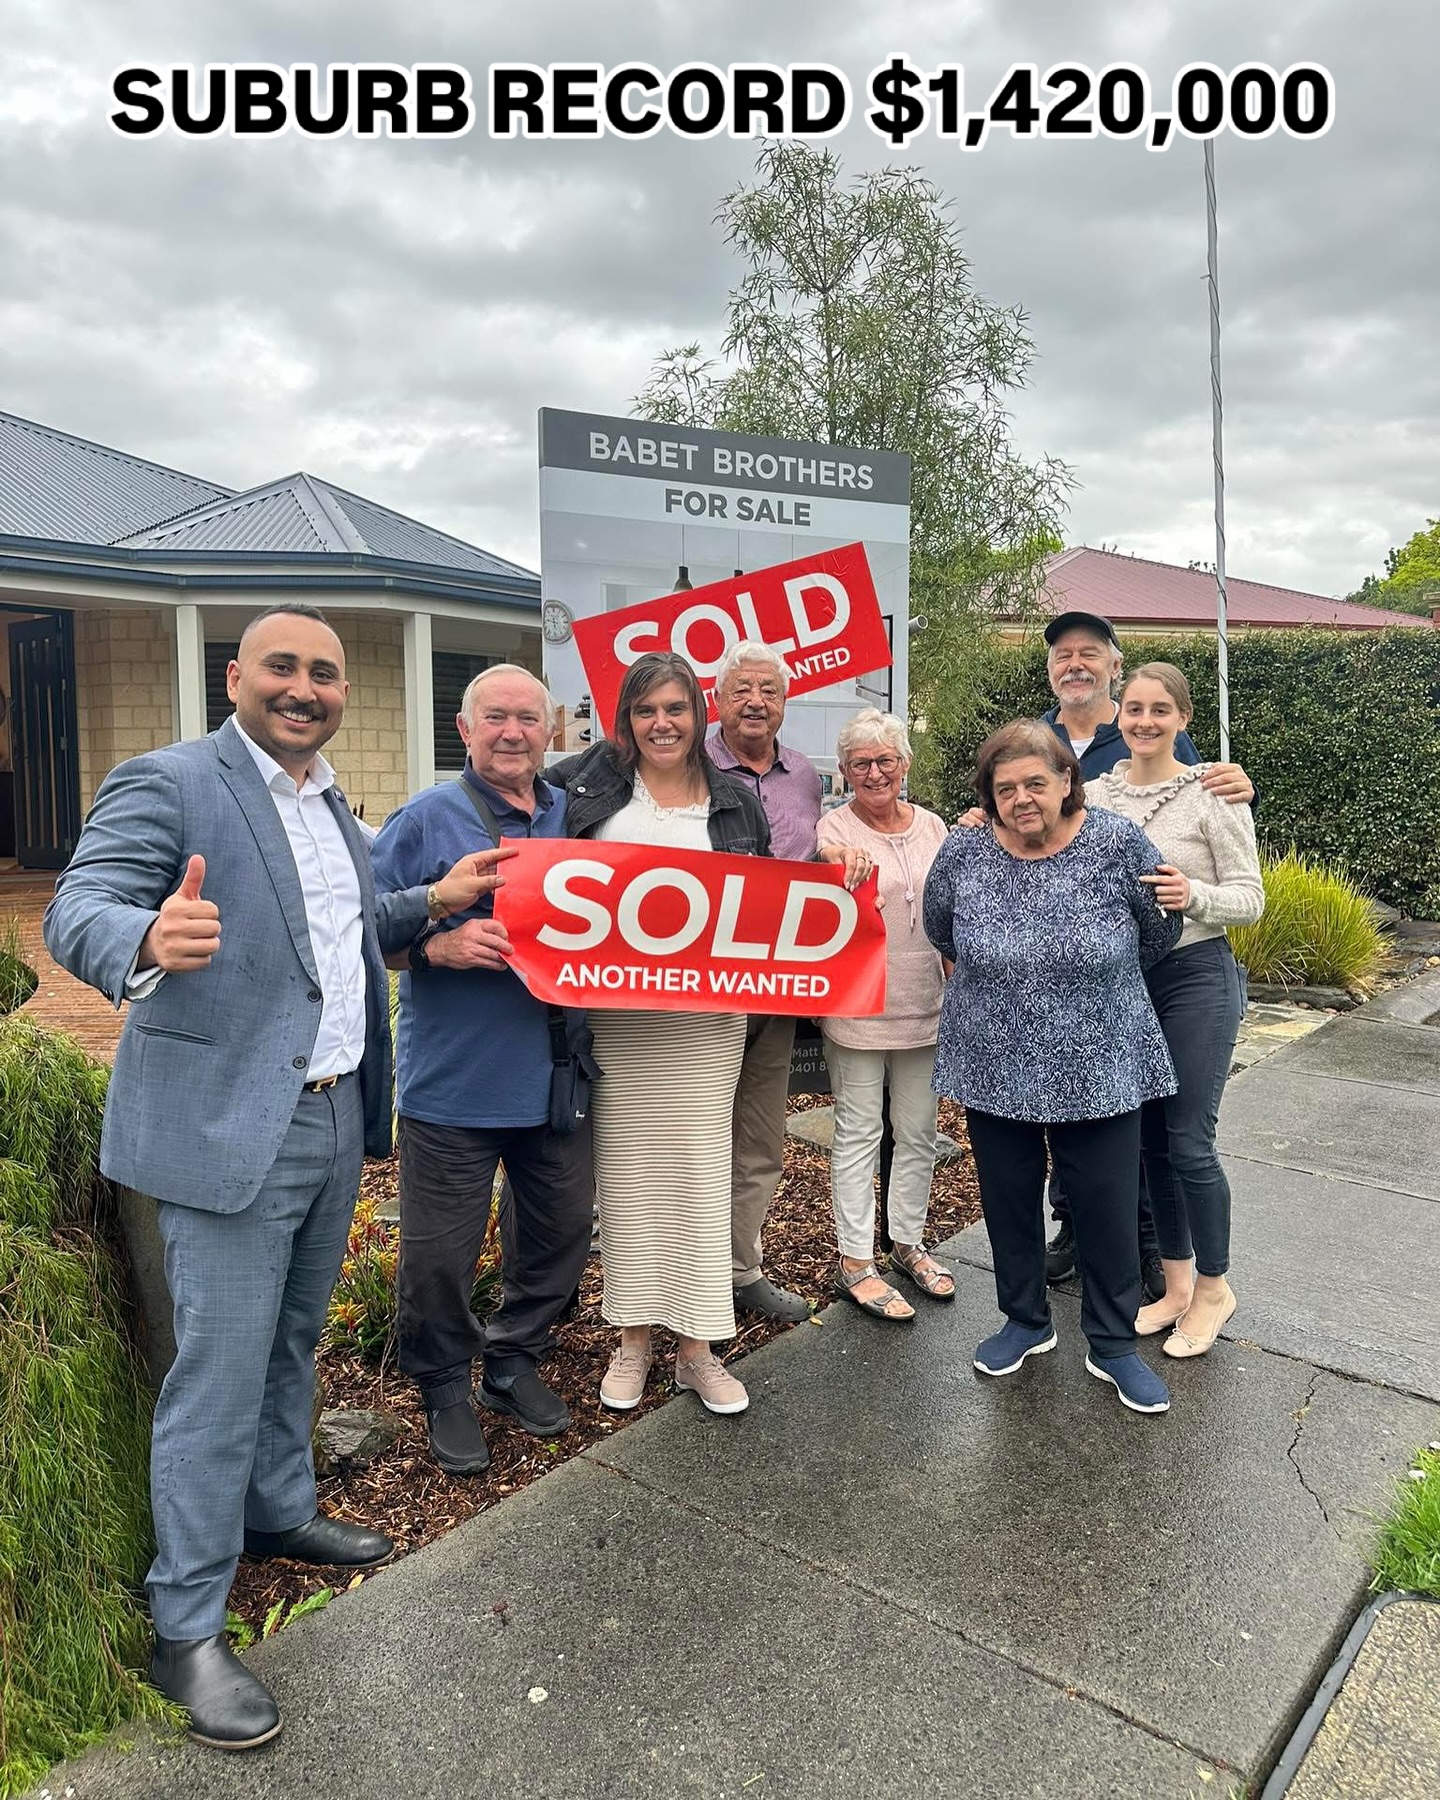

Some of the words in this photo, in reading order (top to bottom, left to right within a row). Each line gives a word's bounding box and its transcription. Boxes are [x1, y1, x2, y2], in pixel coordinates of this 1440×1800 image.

[589, 431, 699, 471] BABET
[713, 447, 875, 491] BROTHERS
[665, 487, 728, 519] FOR
[736, 496, 811, 527] SALE
[535, 858, 858, 963] SOLD
[555, 962, 701, 993] ANOTHER
[708, 969, 831, 998] WANTED
[792, 1047, 818, 1058] Matt
